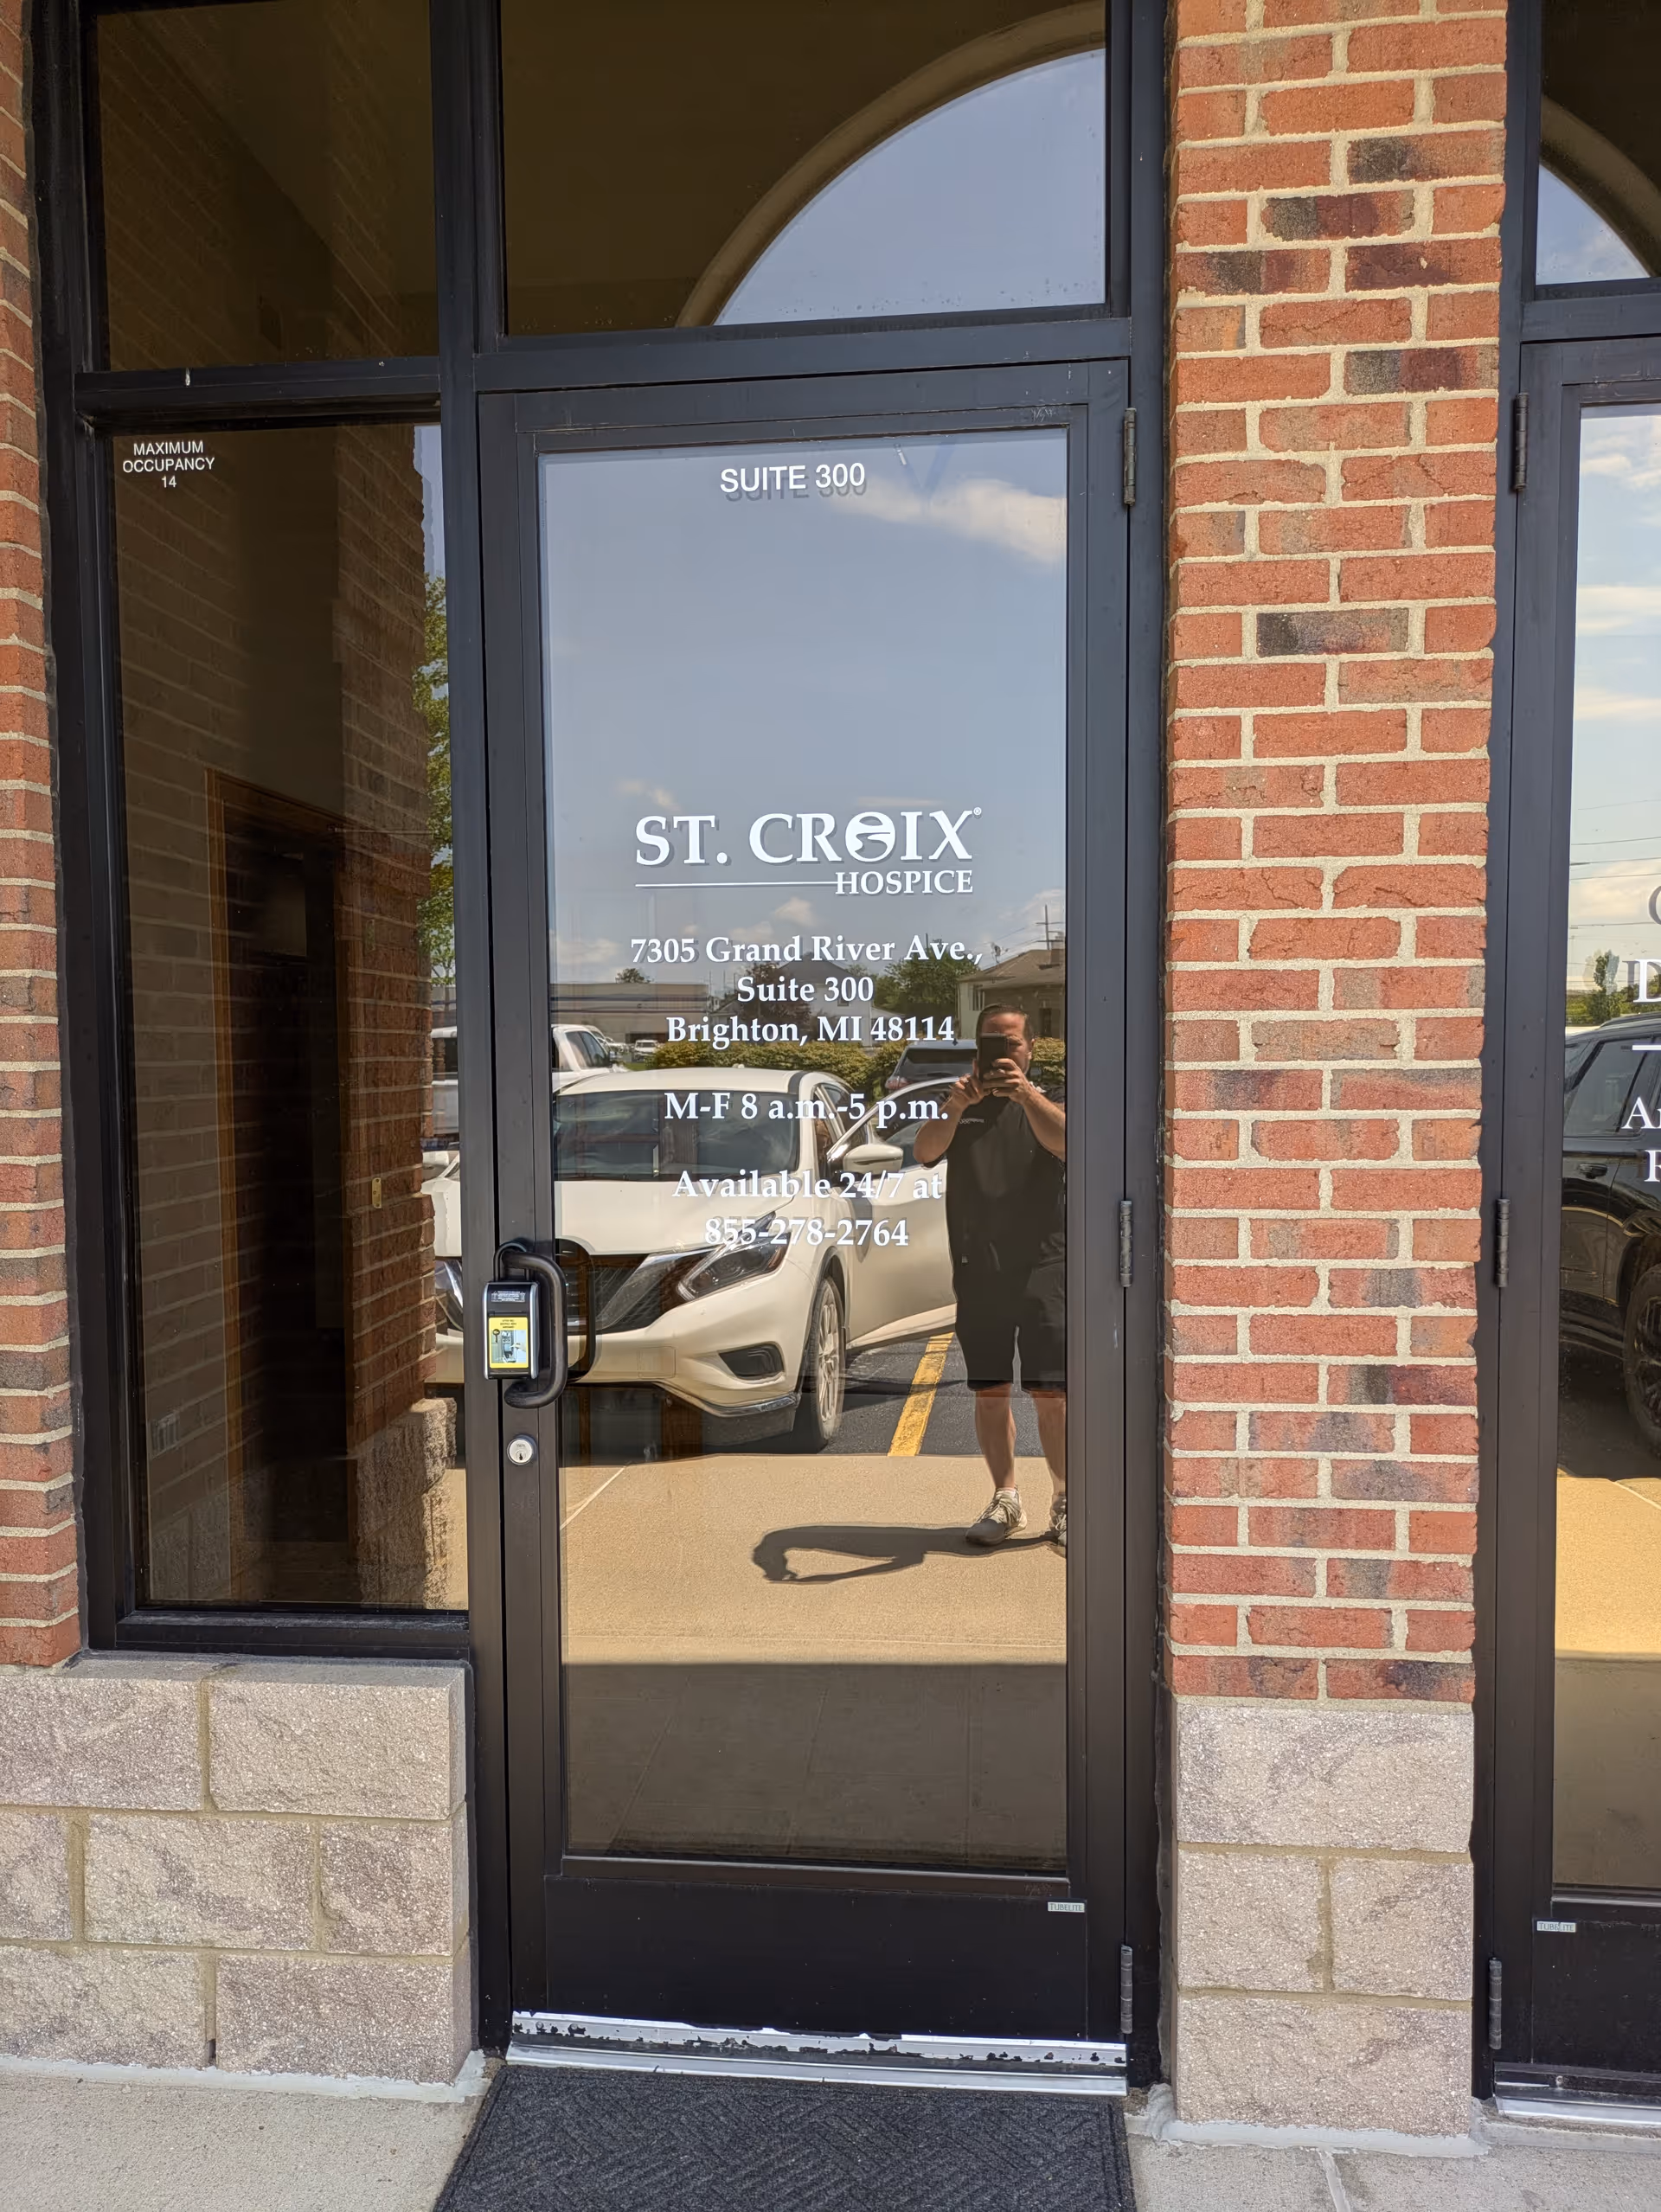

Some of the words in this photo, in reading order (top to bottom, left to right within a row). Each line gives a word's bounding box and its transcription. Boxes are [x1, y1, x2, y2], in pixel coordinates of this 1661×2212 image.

[133, 439, 204, 456] MAXIMUM
[122, 457, 215, 473] OCCUPANCY
[720, 465, 806, 493] SUITE
[815, 462, 866, 489] 300
[161, 474, 177, 489] 14
[635, 815, 728, 866] ST.
[835, 869, 973, 894] HOSPICE
[631, 938, 696, 963] 7305
[706, 935, 800, 963] Grand
[811, 934, 896, 962] River
[904, 934, 984, 965] Ave.,
[737, 977, 815, 1003] Suite
[824, 977, 874, 1002] 300
[666, 1015, 808, 1050] Brighton,
[818, 1016, 863, 1042] MI
[870, 1016, 955, 1042] 48114
[664, 1093, 731, 1120] M-F
[741, 1093, 758, 1120] 8
[876, 1100, 949, 1129] p.m.
[672, 1169, 831, 1199] Available
[839, 1170, 905, 1200] 24/7
[913, 1172, 943, 1200] at
[705, 1217, 910, 1247] 855-278-2764
[1049, 1903, 1083, 1912] TUBELITE
